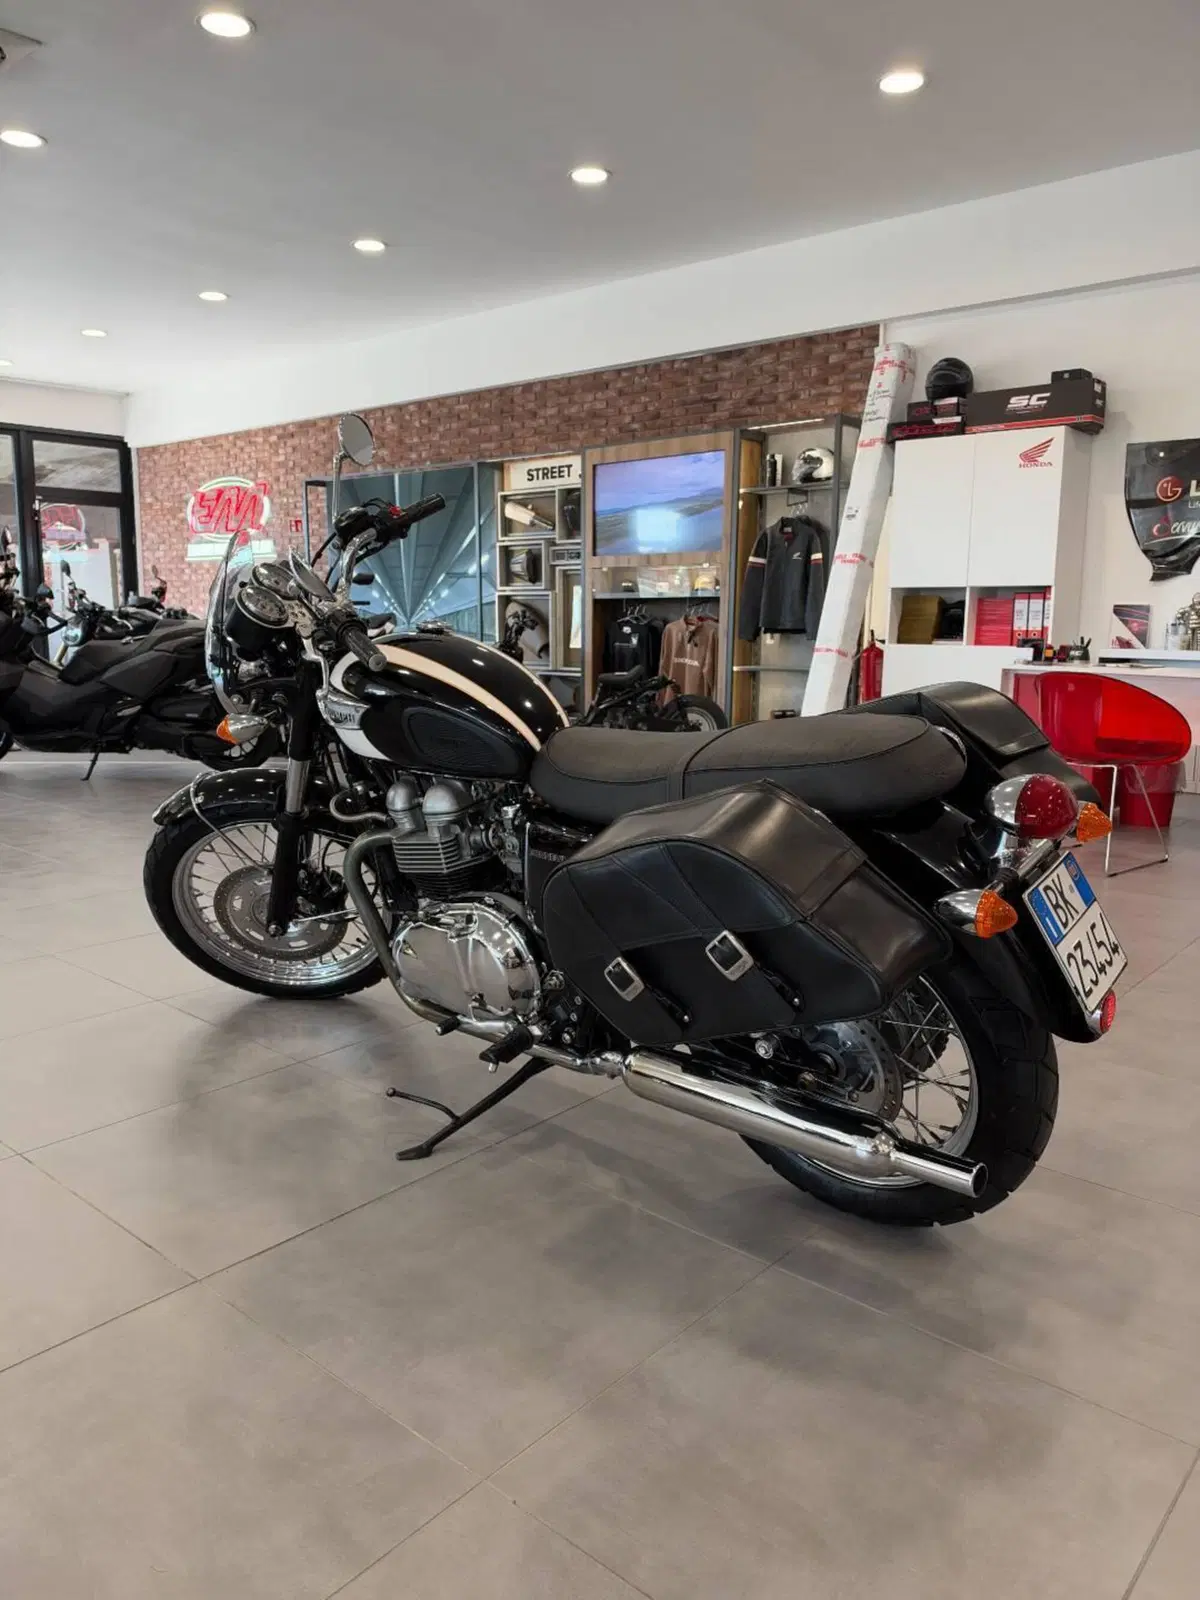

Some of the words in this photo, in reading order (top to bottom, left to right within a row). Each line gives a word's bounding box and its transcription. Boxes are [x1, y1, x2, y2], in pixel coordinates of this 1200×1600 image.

[1007, 392, 1052, 408] SC
[526, 464, 573, 482] STREET
[1018, 461, 1053, 469] HONDA
[1042, 872, 1080, 930] BK
[1066, 911, 1120, 999] 23454
